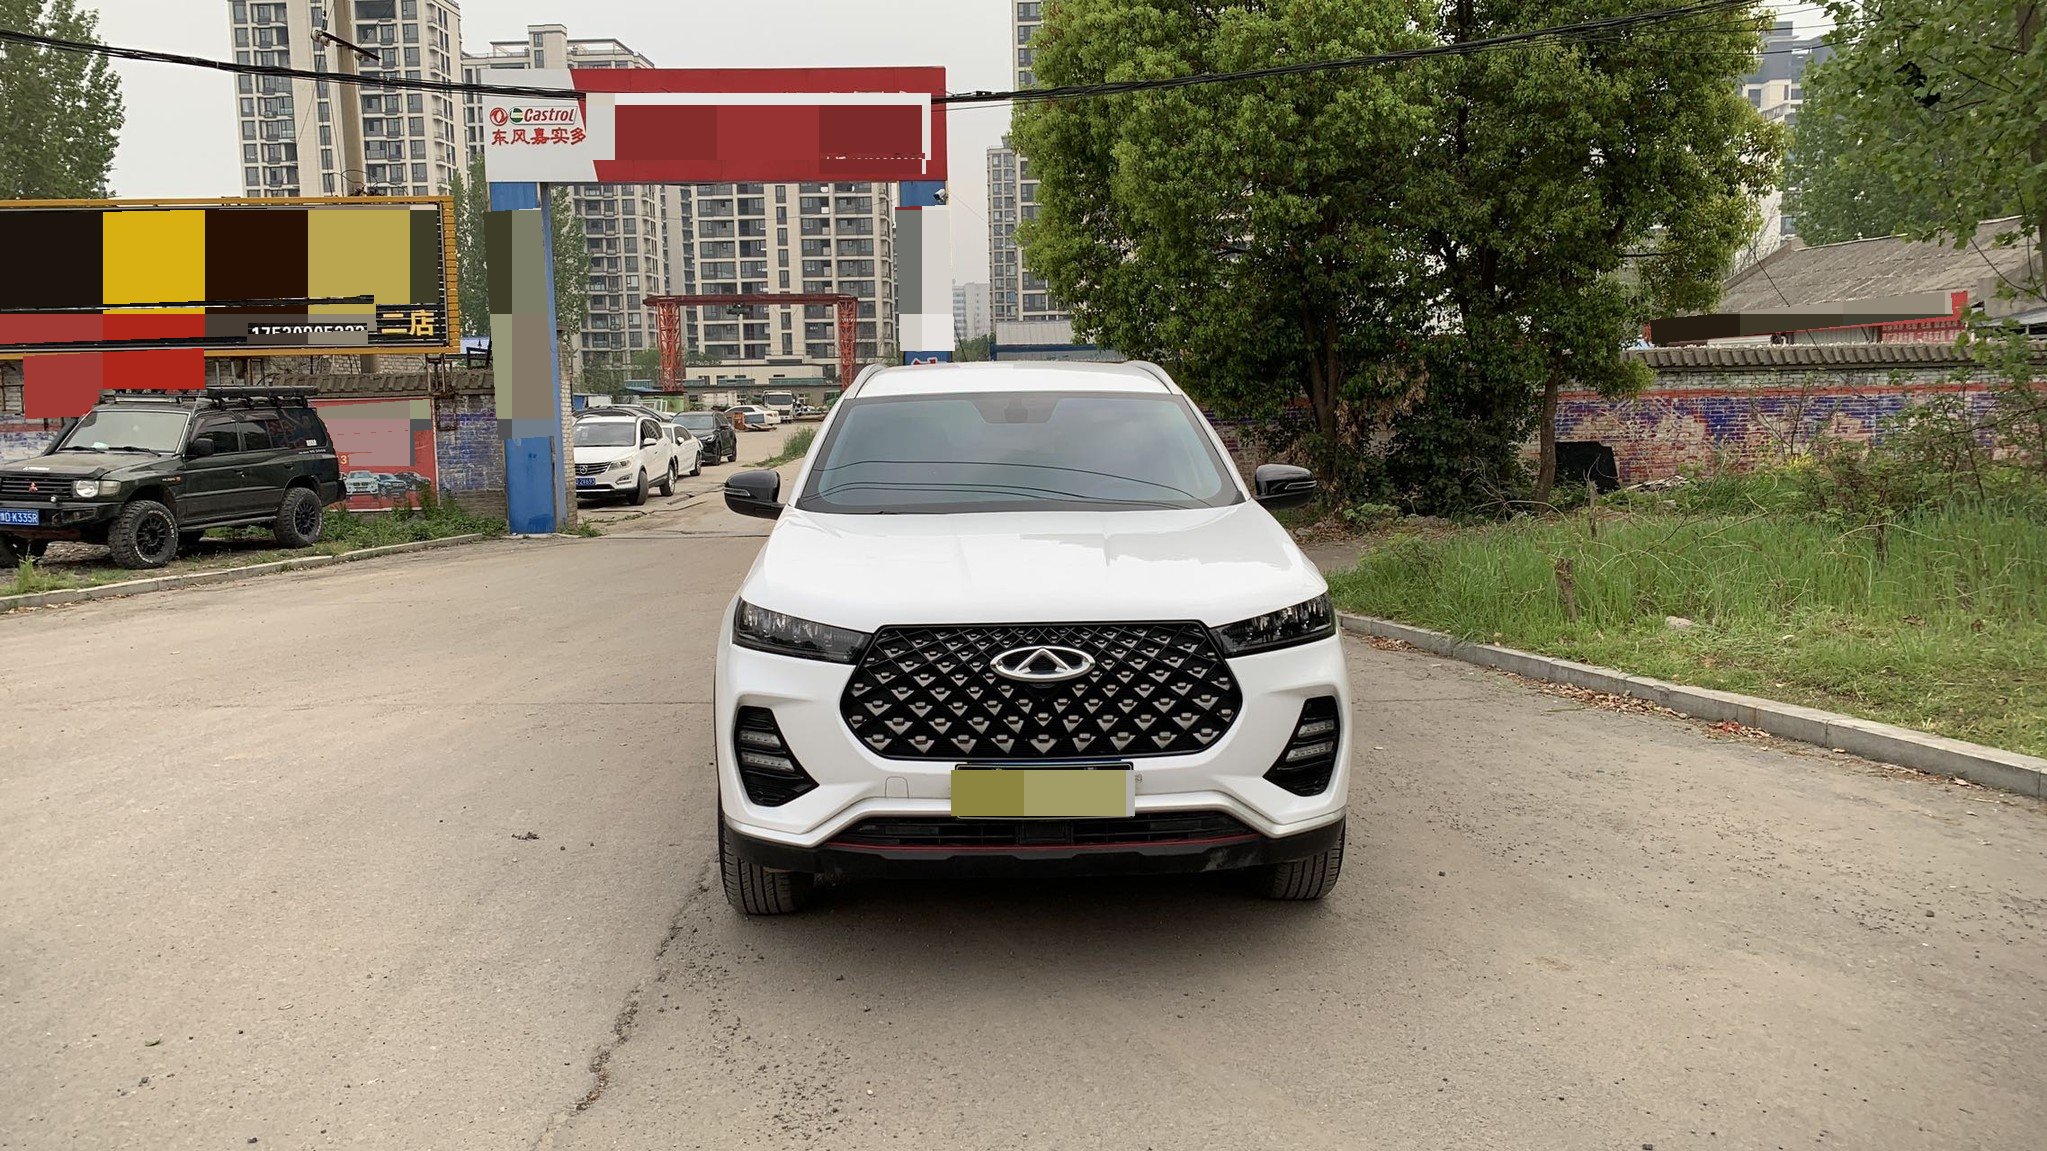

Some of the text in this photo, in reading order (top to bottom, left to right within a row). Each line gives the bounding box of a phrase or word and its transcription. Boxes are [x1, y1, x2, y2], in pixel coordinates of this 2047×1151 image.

[524, 108, 575, 122] Castrol
[491, 127, 586, 145] 东风嘉实多
[381, 310, 435, 336] 二店
